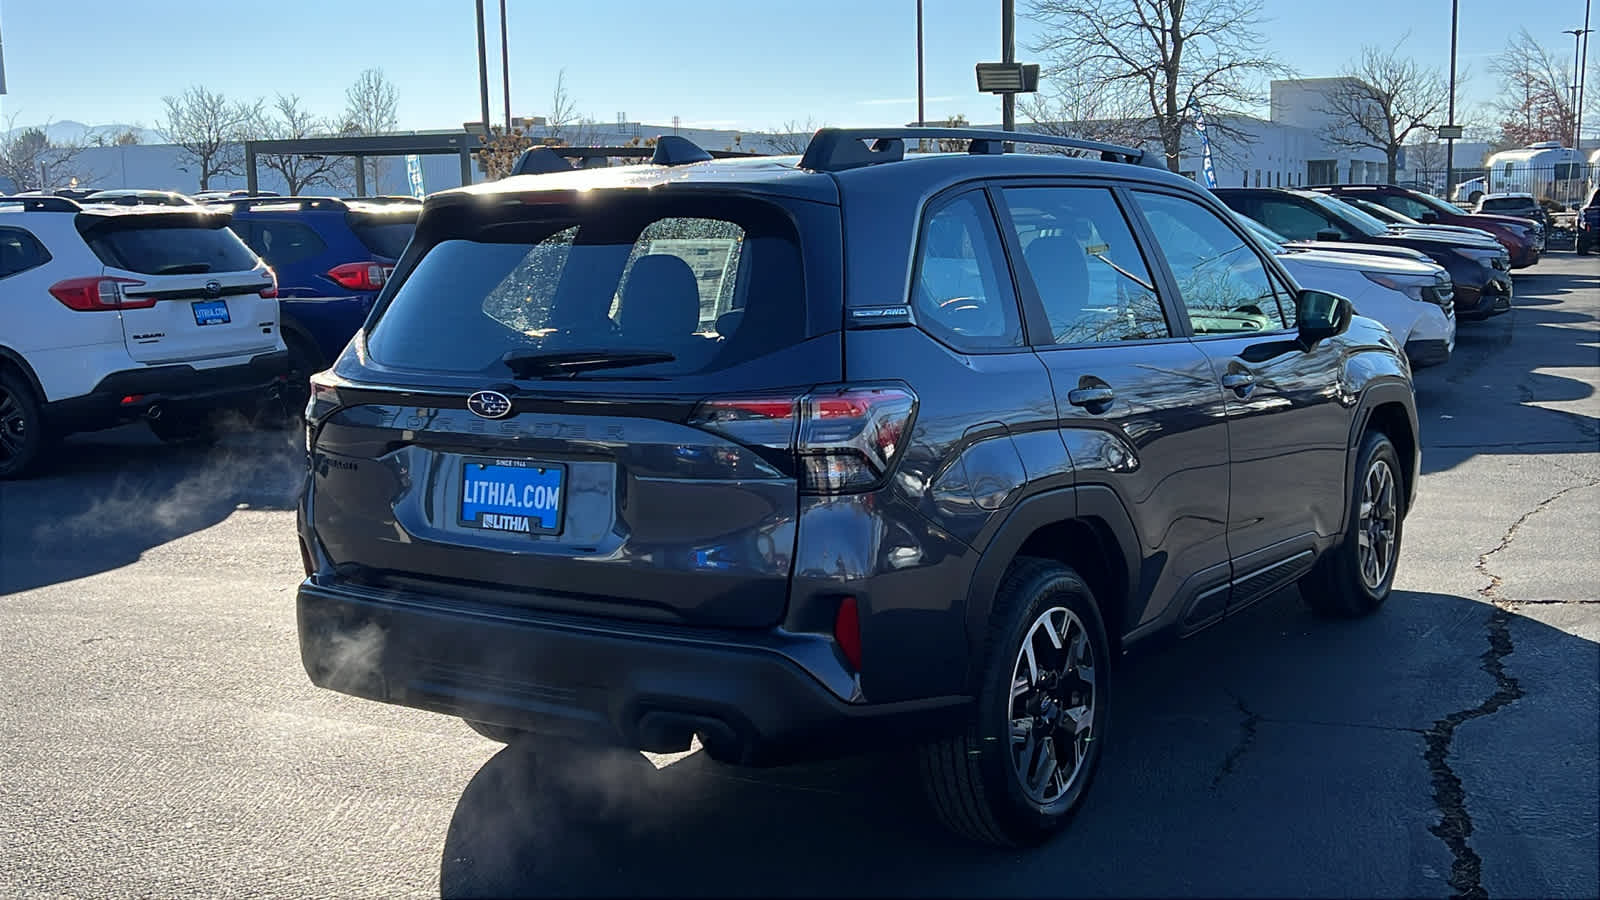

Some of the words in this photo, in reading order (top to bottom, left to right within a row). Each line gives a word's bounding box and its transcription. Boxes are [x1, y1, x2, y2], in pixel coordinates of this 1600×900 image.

[496, 459, 512, 467] SINCE
[463, 480, 560, 511] LITHIA.COM
[493, 514, 530, 532] LITHIA
